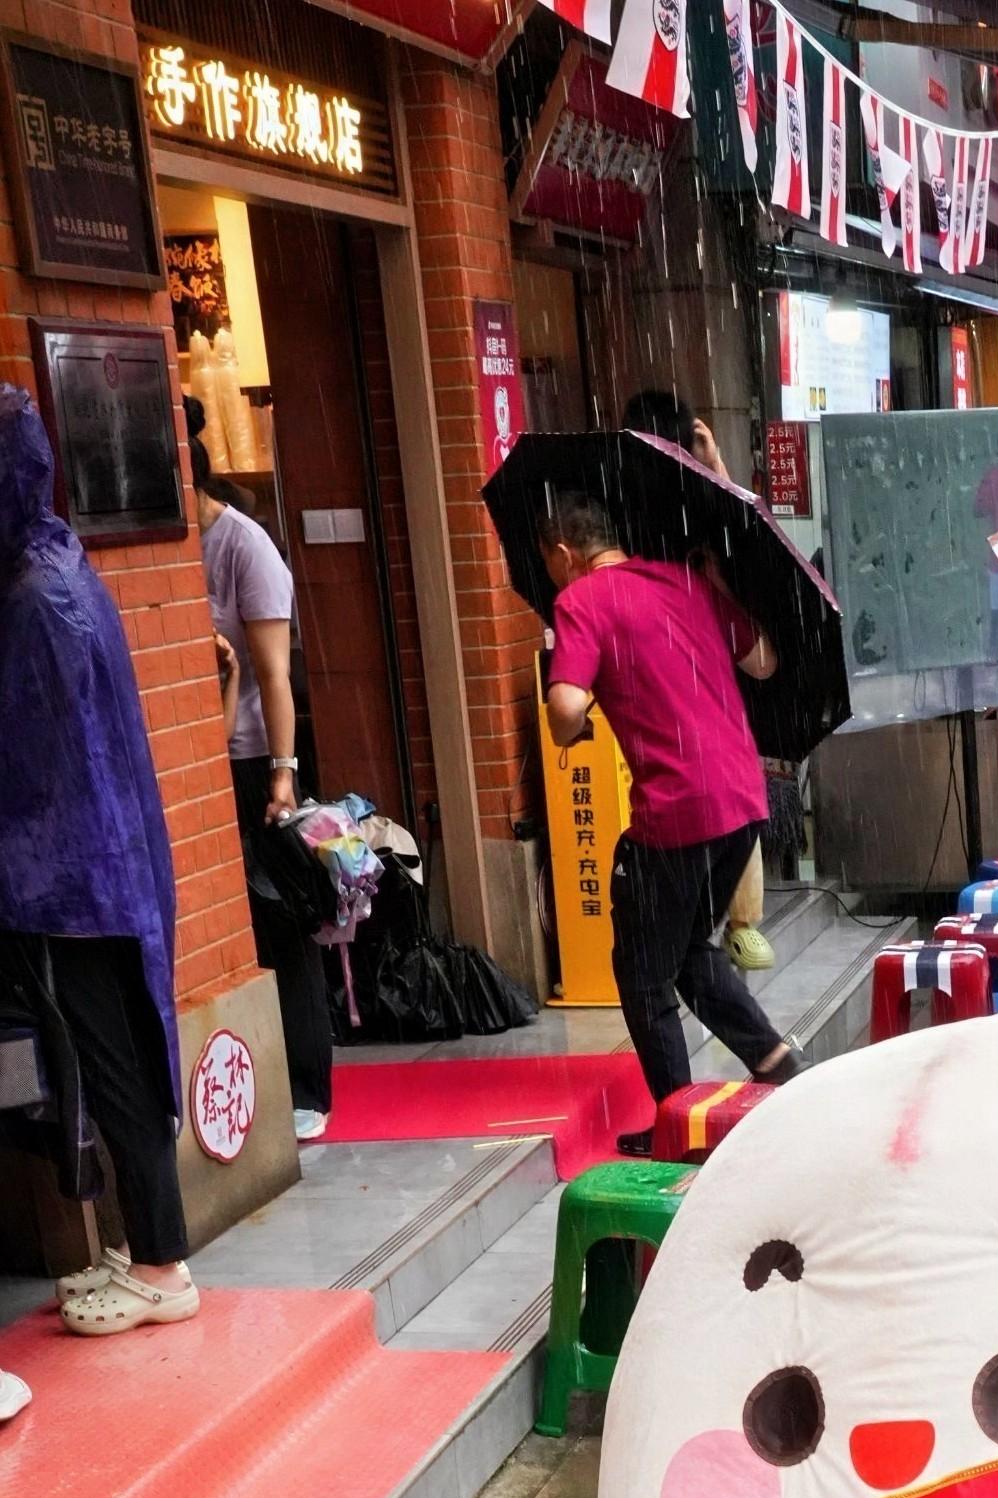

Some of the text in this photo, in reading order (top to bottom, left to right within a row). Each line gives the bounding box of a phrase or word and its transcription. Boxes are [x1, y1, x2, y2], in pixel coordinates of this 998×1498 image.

[149, 46, 363, 174] 手作旗舰店
[54, 114, 133, 159] 中华老字号
[768, 426, 794, 438] 2.5元
[769, 442, 796, 454] 2.5元
[770, 458, 795, 470] 2.5元
[772, 474, 797, 486] 2.5元
[772, 490, 798, 502] 3.0元
[572, 767, 602, 916] 超级快充·充电宝
